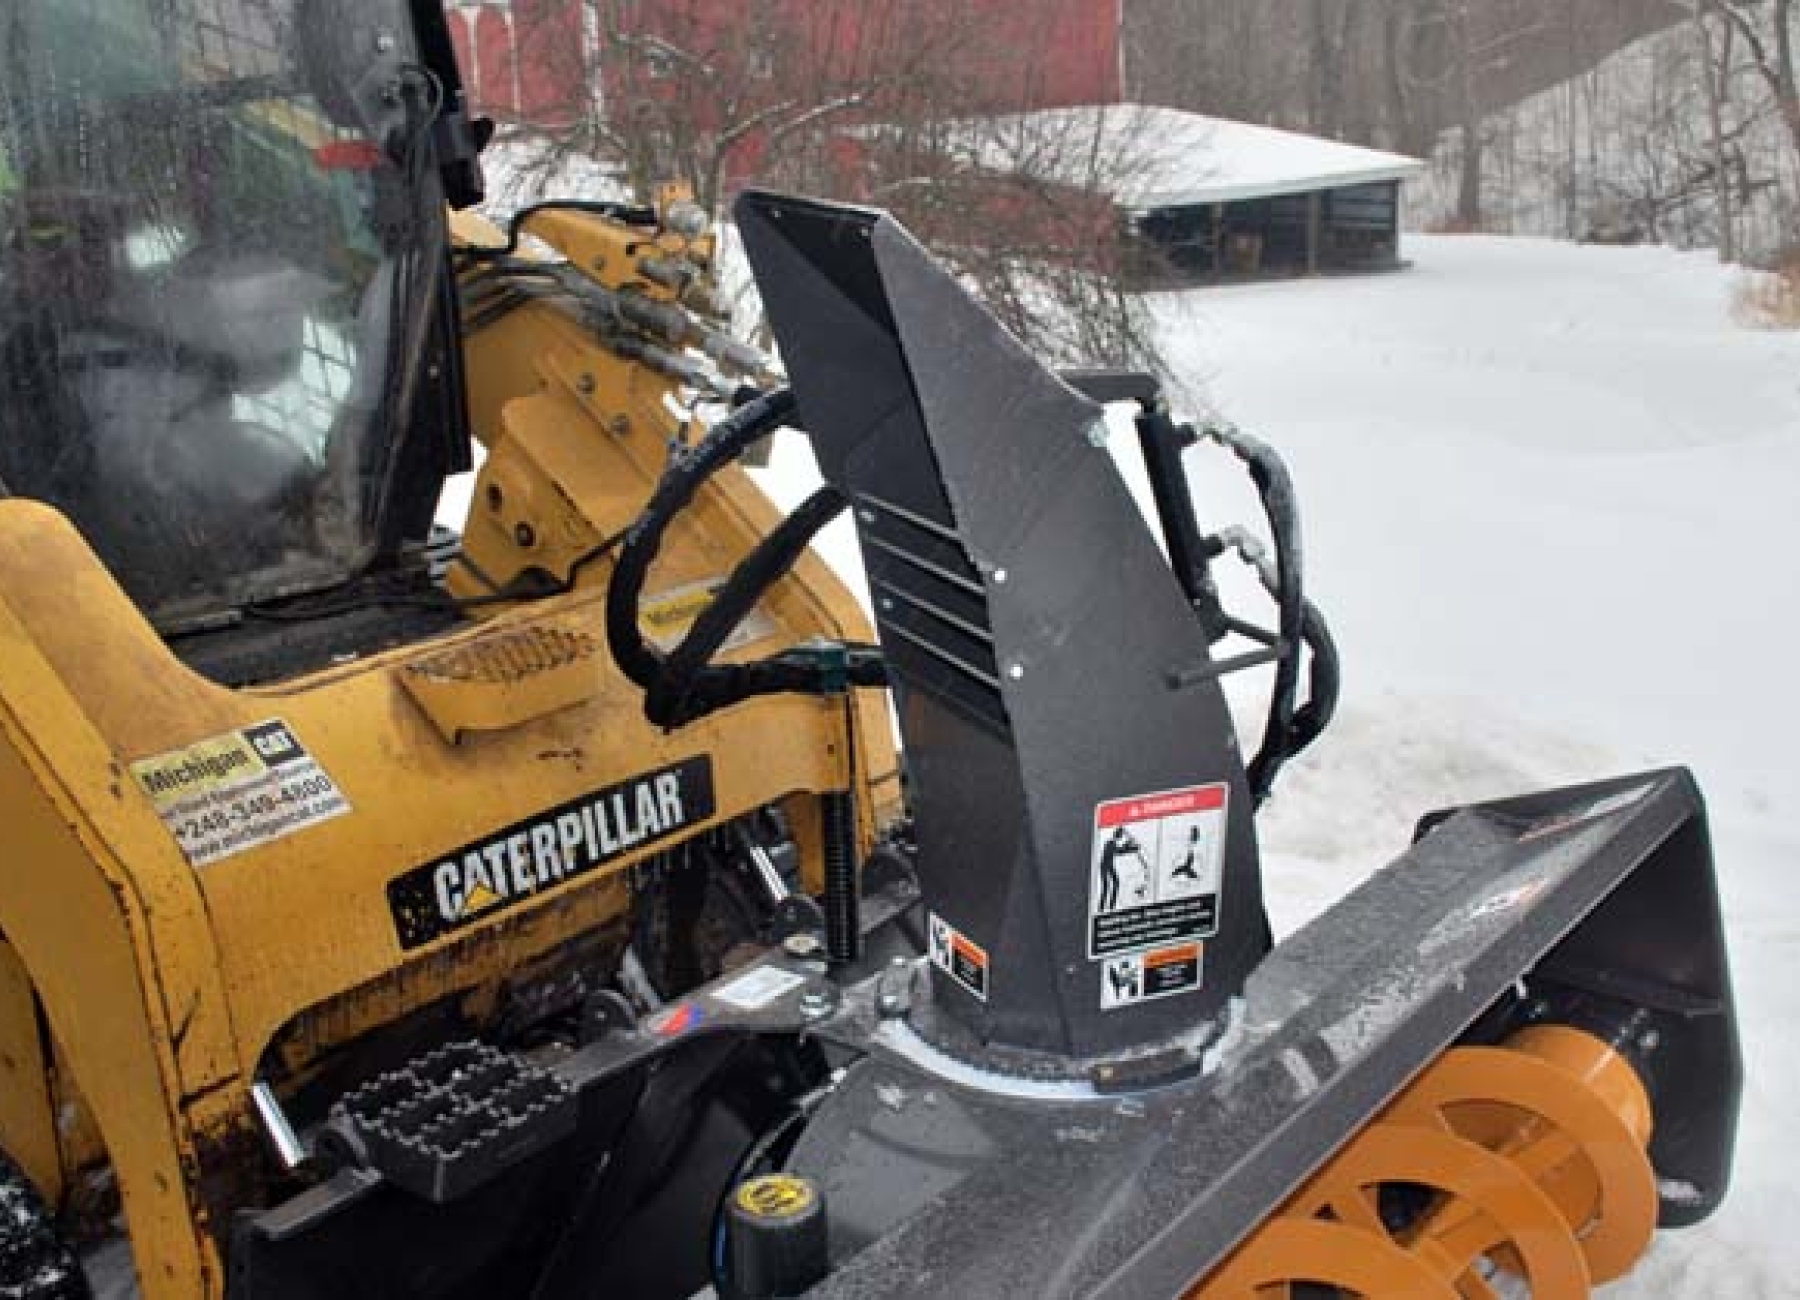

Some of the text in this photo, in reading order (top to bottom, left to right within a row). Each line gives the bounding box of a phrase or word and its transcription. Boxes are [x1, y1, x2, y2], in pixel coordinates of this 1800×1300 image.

[142, 748, 249, 793] Michigan
[253, 730, 293, 755] CAT
[433, 772, 684, 922] CATERPILLAR
